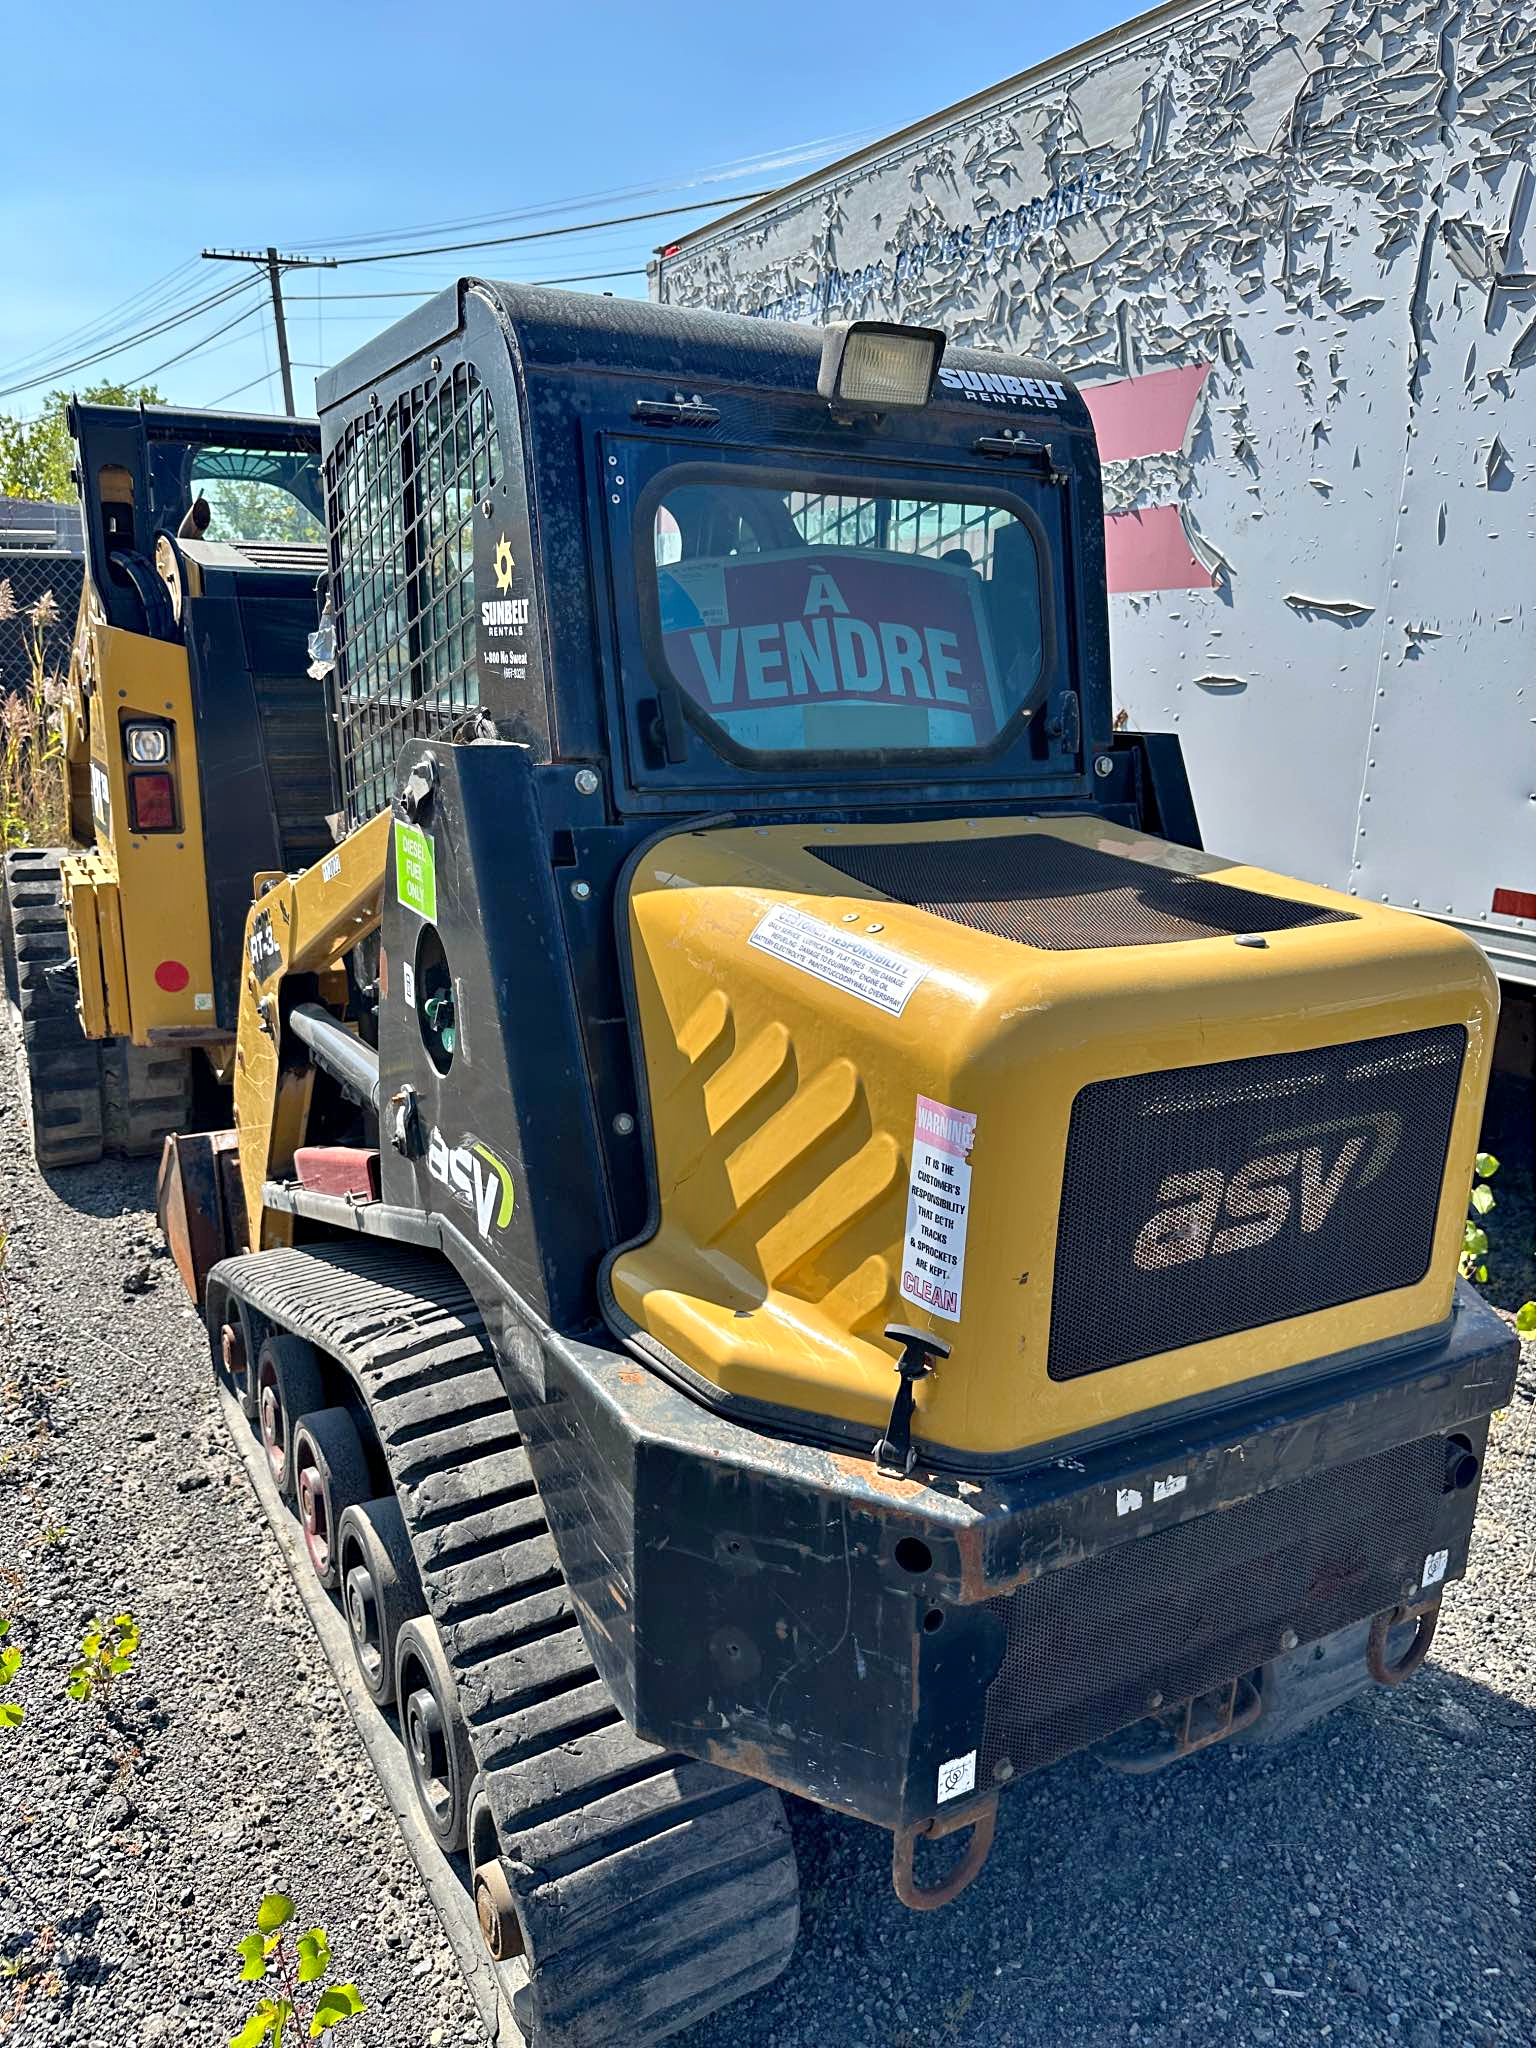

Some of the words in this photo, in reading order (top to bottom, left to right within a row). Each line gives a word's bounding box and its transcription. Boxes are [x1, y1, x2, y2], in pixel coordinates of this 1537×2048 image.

[938, 367, 1067, 401] SUNBELT
[964, 390, 1058, 409] RENTALS
[803, 564, 850, 616] À
[481, 599, 529, 626] SUNBELT
[488, 626, 523, 637] RENTALS
[484, 651, 499, 664] 1-800
[500, 650, 509, 664] No
[510, 650, 528, 665] Sweat
[690, 616, 970, 705] VENDRE
[403, 836, 426, 865] DIESEL
[406, 859, 424, 883] FUEL
[407, 880, 425, 906] ONLY
[250, 926, 281, 964] RT-3
[773, 943, 807, 962] ELECTROLYTE
[868, 987, 901, 1008] OVERSPRAY
[799, 945, 821, 959] DAMAGE
[821, 954, 828, 963] TO
[827, 957, 859, 976] EQUIPMENT
[859, 973, 879, 987] ENGINE
[879, 982, 888, 992] OIL
[836, 952, 851, 962] FLAT
[851, 958, 866, 970] TIRES
[868, 966, 881, 977] TIRE
[880, 973, 905, 988] DAMAGE
[919, 1105, 971, 1146] WARNING
[925, 1155, 932, 1167] IT
[932, 1159, 940, 1170] IS
[941, 1162, 954, 1176] THE
[917, 1170, 961, 1196] CUSTOMER'S
[911, 1185, 966, 1215] RESPONSIBILITY
[918, 1205, 934, 1221] THAT
[934, 1213, 954, 1230] BOTH
[921, 1224, 947, 1245] TRACKS
[910, 1237, 916, 1248] &
[917, 1240, 958, 1266] SPROCKETS
[915, 1257, 928, 1272] ARE
[929, 1264, 947, 1280] KEPT
[903, 1270, 958, 1313] CLEAN
